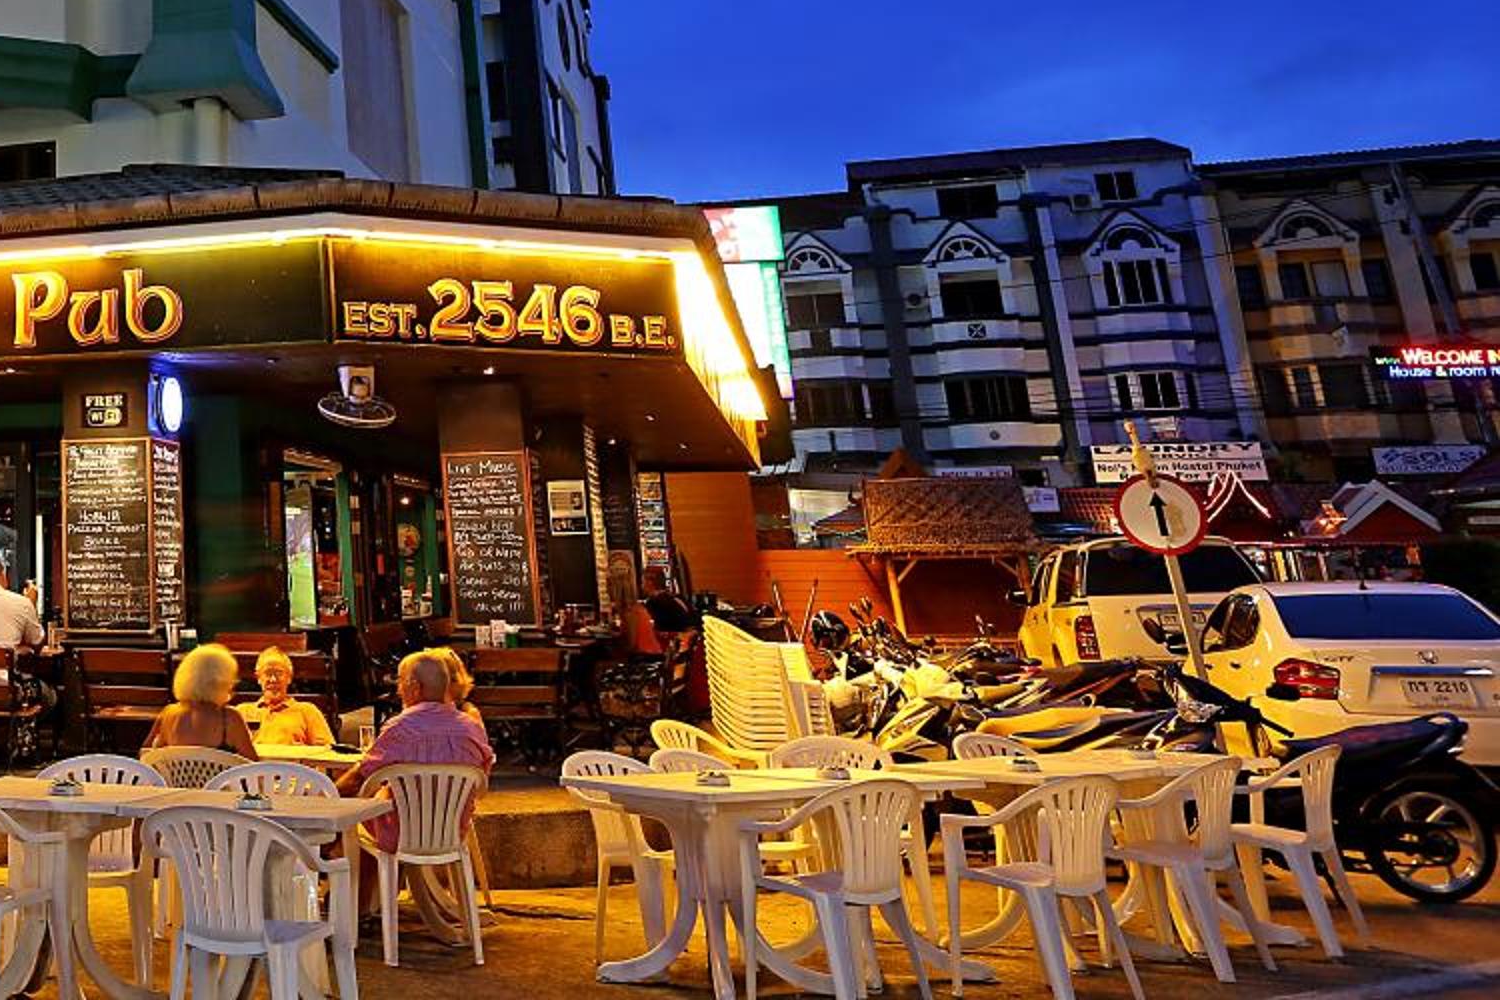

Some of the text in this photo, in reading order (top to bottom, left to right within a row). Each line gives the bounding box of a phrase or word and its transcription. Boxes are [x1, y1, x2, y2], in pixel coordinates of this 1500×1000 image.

[11, 267, 184, 348] Pub
[343, 278, 677, 349] EST. 2546 B.E.
[1401, 348, 1485, 365] WELCOME
[1389, 366, 1432, 377] House
[1449, 367, 1486, 377] room
[85, 395, 124, 408] FREE
